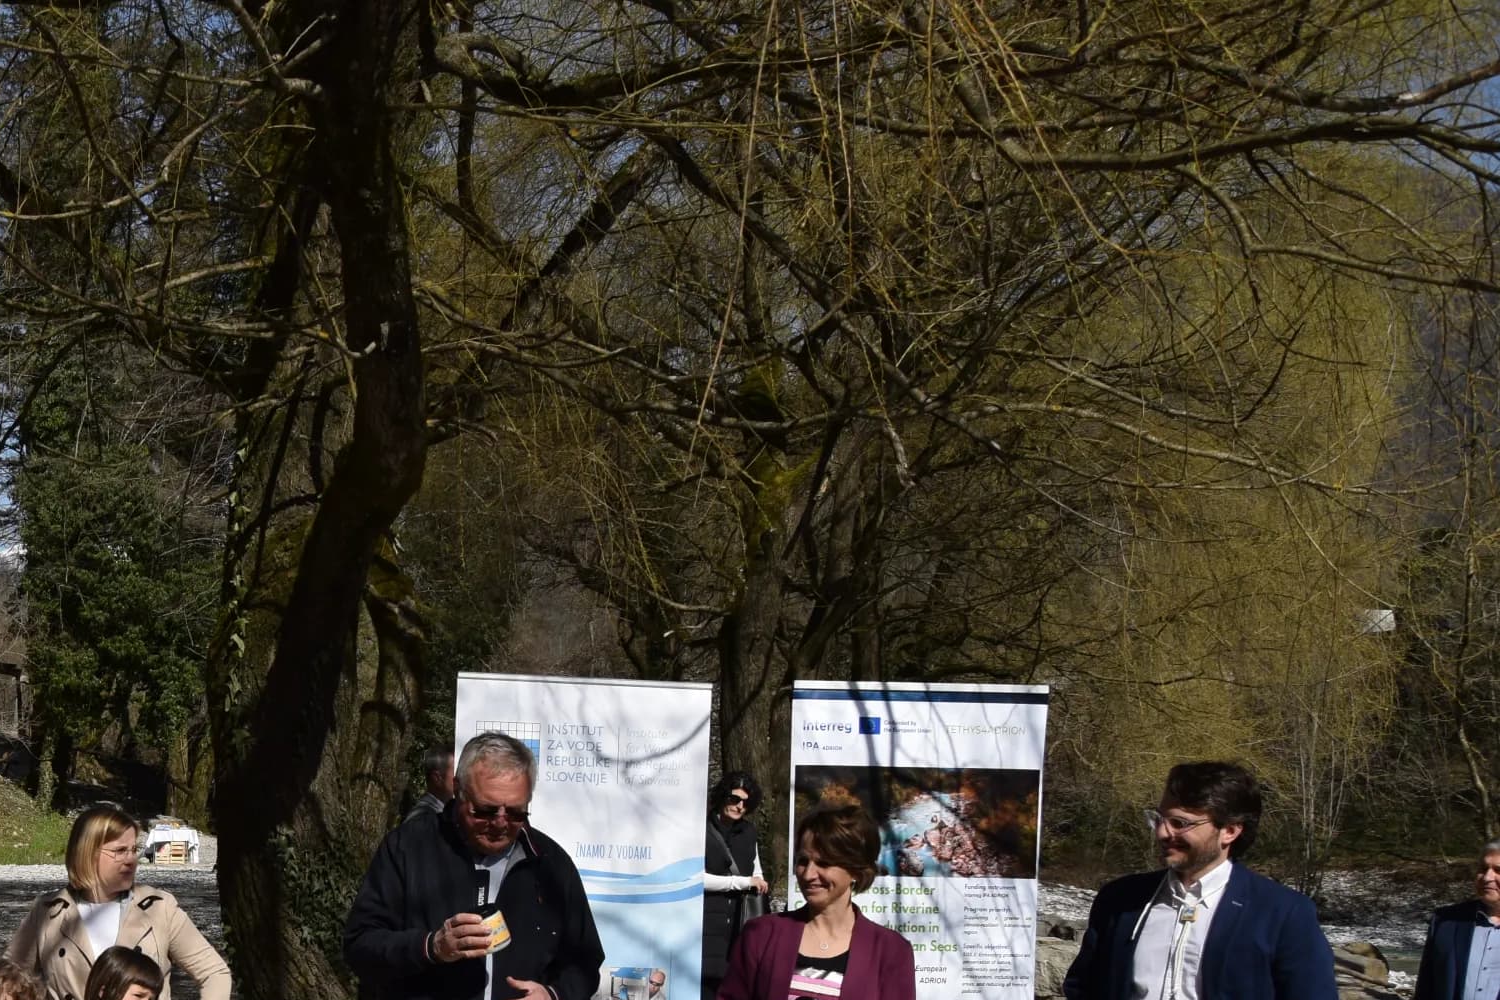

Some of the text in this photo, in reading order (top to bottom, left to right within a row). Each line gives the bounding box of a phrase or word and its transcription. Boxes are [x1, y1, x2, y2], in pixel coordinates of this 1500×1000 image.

[802, 720, 852, 733] Interreg
[547, 739, 603, 752] ZA VODE
[802, 740, 820, 751] IPA
[546, 755, 611, 769] REPUBLIKE
[545, 771, 607, 786] SLOVENIJE
[575, 842, 652, 860] ZNAMO Z VODAMI
[867, 883, 936, 896] ross-Border
[871, 901, 888, 913] for
[891, 902, 940, 914] Riverine
[883, 921, 940, 933] duction in
[930, 940, 958, 952] Seas
[915, 965, 947, 973] European
[919, 977, 948, 985] ADRION
